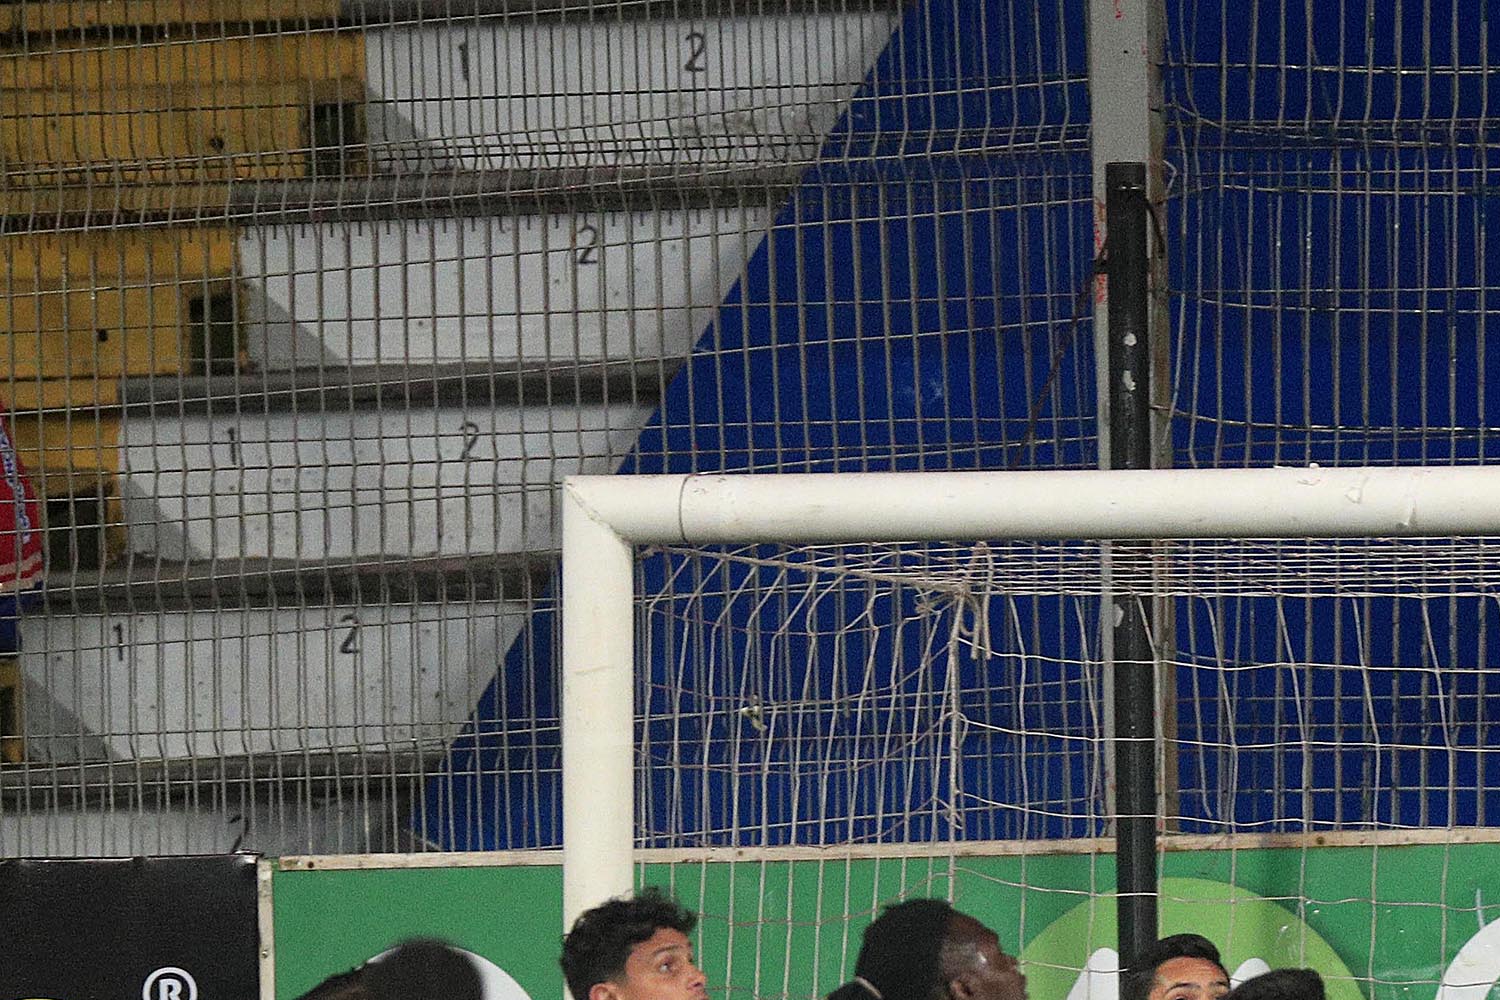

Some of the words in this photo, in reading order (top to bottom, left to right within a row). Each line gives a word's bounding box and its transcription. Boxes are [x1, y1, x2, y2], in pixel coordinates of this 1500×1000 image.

[684, 32, 706, 72] 2
[576, 225, 600, 264] 2
[459, 421, 481, 462] 2
[340, 615, 360, 654] 2
